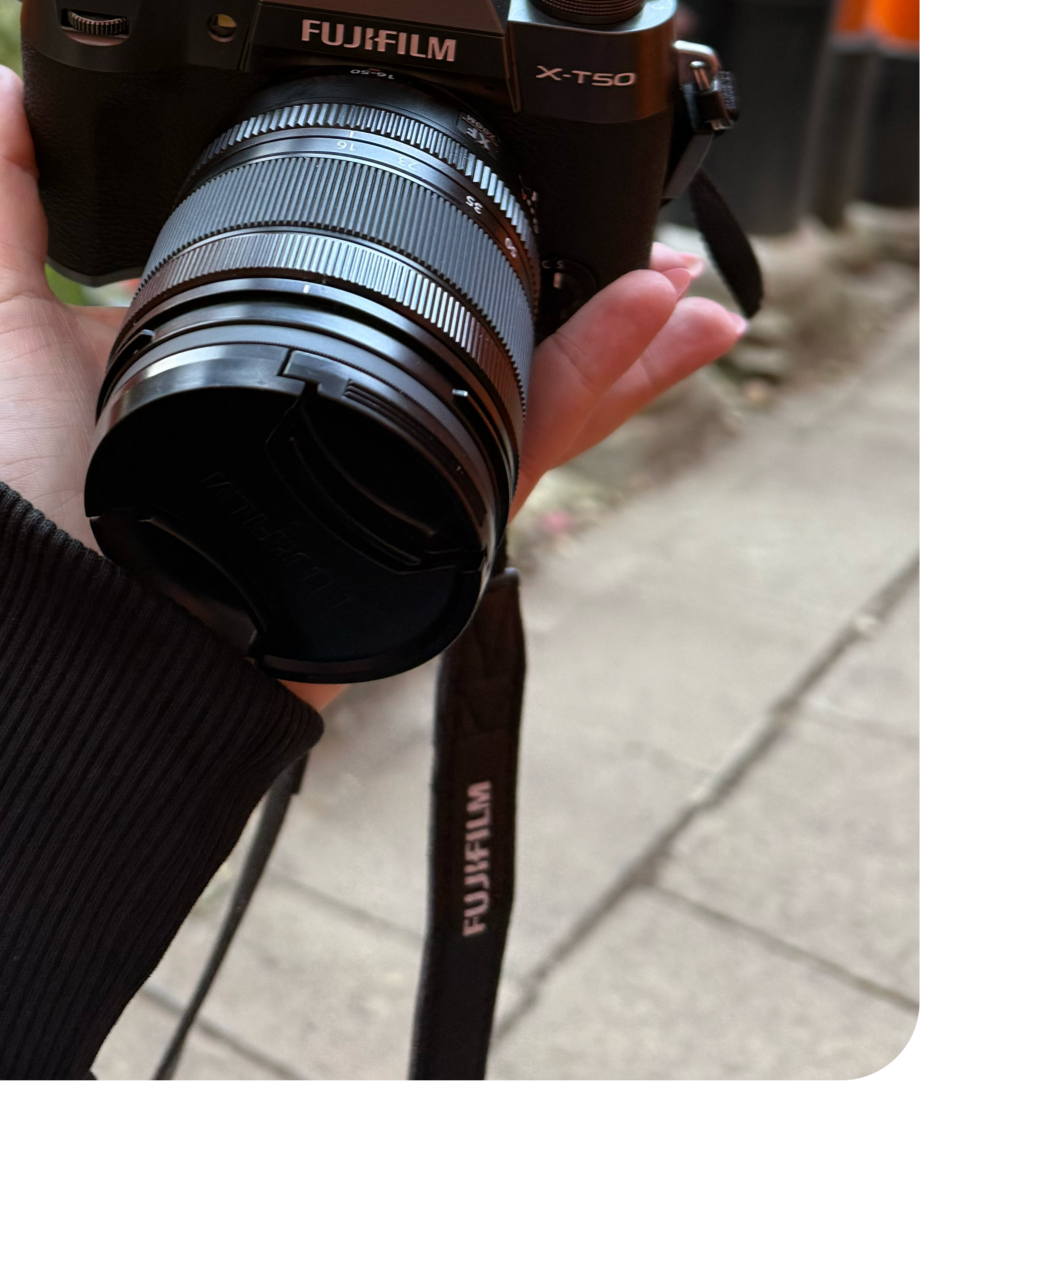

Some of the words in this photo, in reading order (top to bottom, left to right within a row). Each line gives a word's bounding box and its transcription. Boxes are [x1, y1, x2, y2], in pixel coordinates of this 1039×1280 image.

[301, 19, 457, 62] FUJIFILM
[535, 65, 637, 87] X-T50
[336, 141, 356, 152] 16
[466, 127, 491, 150] XF
[398, 156, 419, 170] 23
[465, 195, 482, 215] 35
[462, 780, 493, 937] FUJIFILM
